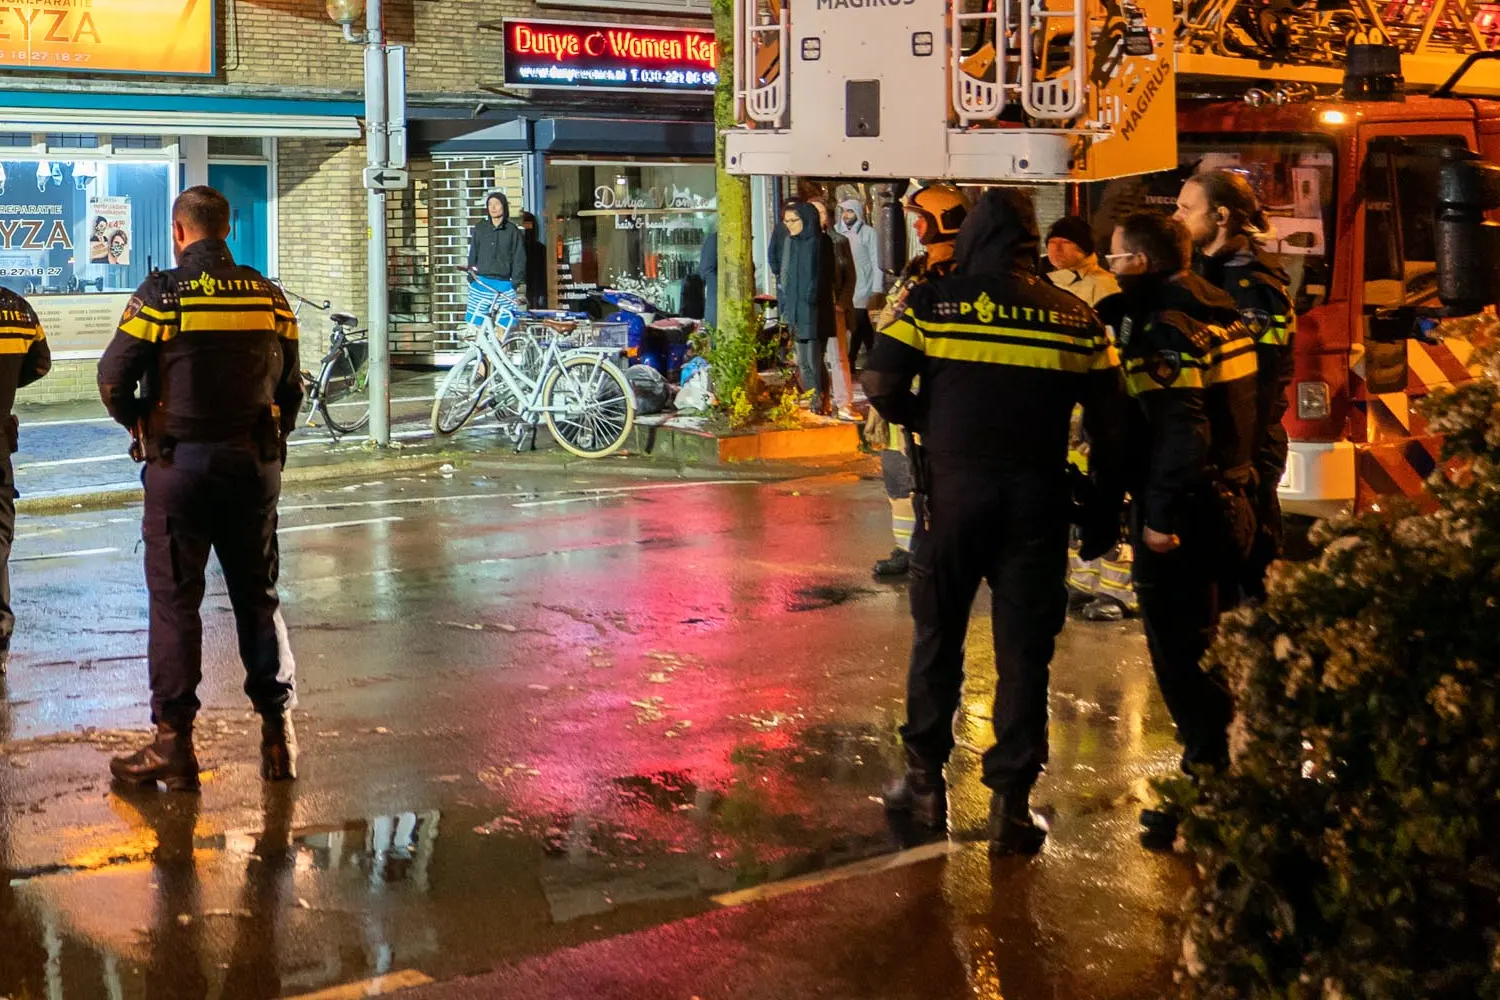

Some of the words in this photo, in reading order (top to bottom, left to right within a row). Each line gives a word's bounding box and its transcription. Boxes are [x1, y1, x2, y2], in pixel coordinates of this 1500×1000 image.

[12, 50, 27, 60] 18
[31, 51, 48, 61] 27
[74, 53, 92, 62] 27
[515, 25, 580, 61] Dunya
[608, 30, 681, 60] Women
[1120, 57, 1171, 142] MAGIRUS
[594, 185, 646, 220] Dunya
